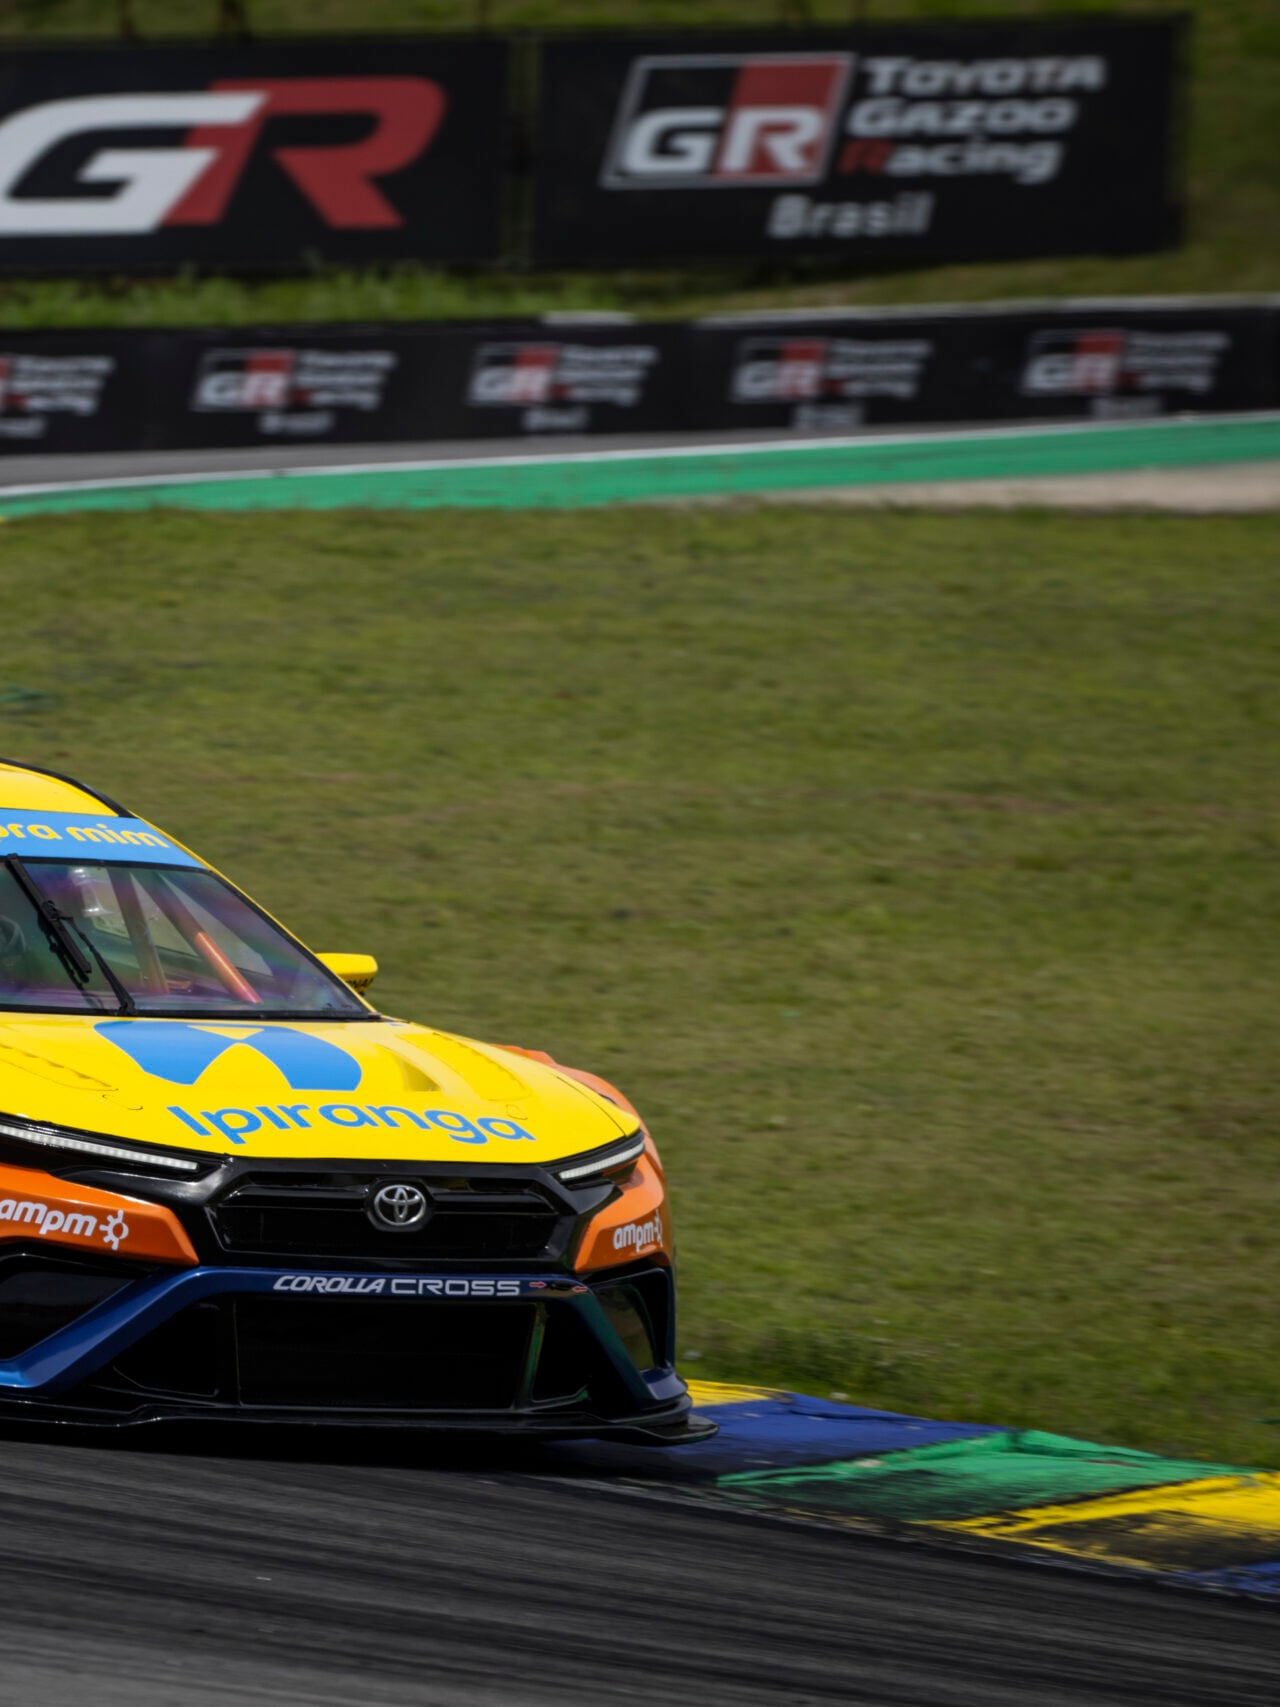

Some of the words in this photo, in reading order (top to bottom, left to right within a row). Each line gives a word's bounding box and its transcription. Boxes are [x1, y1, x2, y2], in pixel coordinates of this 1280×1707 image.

[864, 58, 1107, 96] TOYOTA
[848, 99, 1077, 135] GAZOO
[624, 107, 824, 176] GR
[839, 137, 1063, 184] Racing
[767, 193, 934, 238] Brasil
[65, 822, 171, 849] mim
[166, 1104, 537, 1146] Ipiranga
[613, 1222, 655, 1253] ampm
[273, 1275, 387, 1294] COROLLA
[390, 1278, 520, 1297] CROSS
